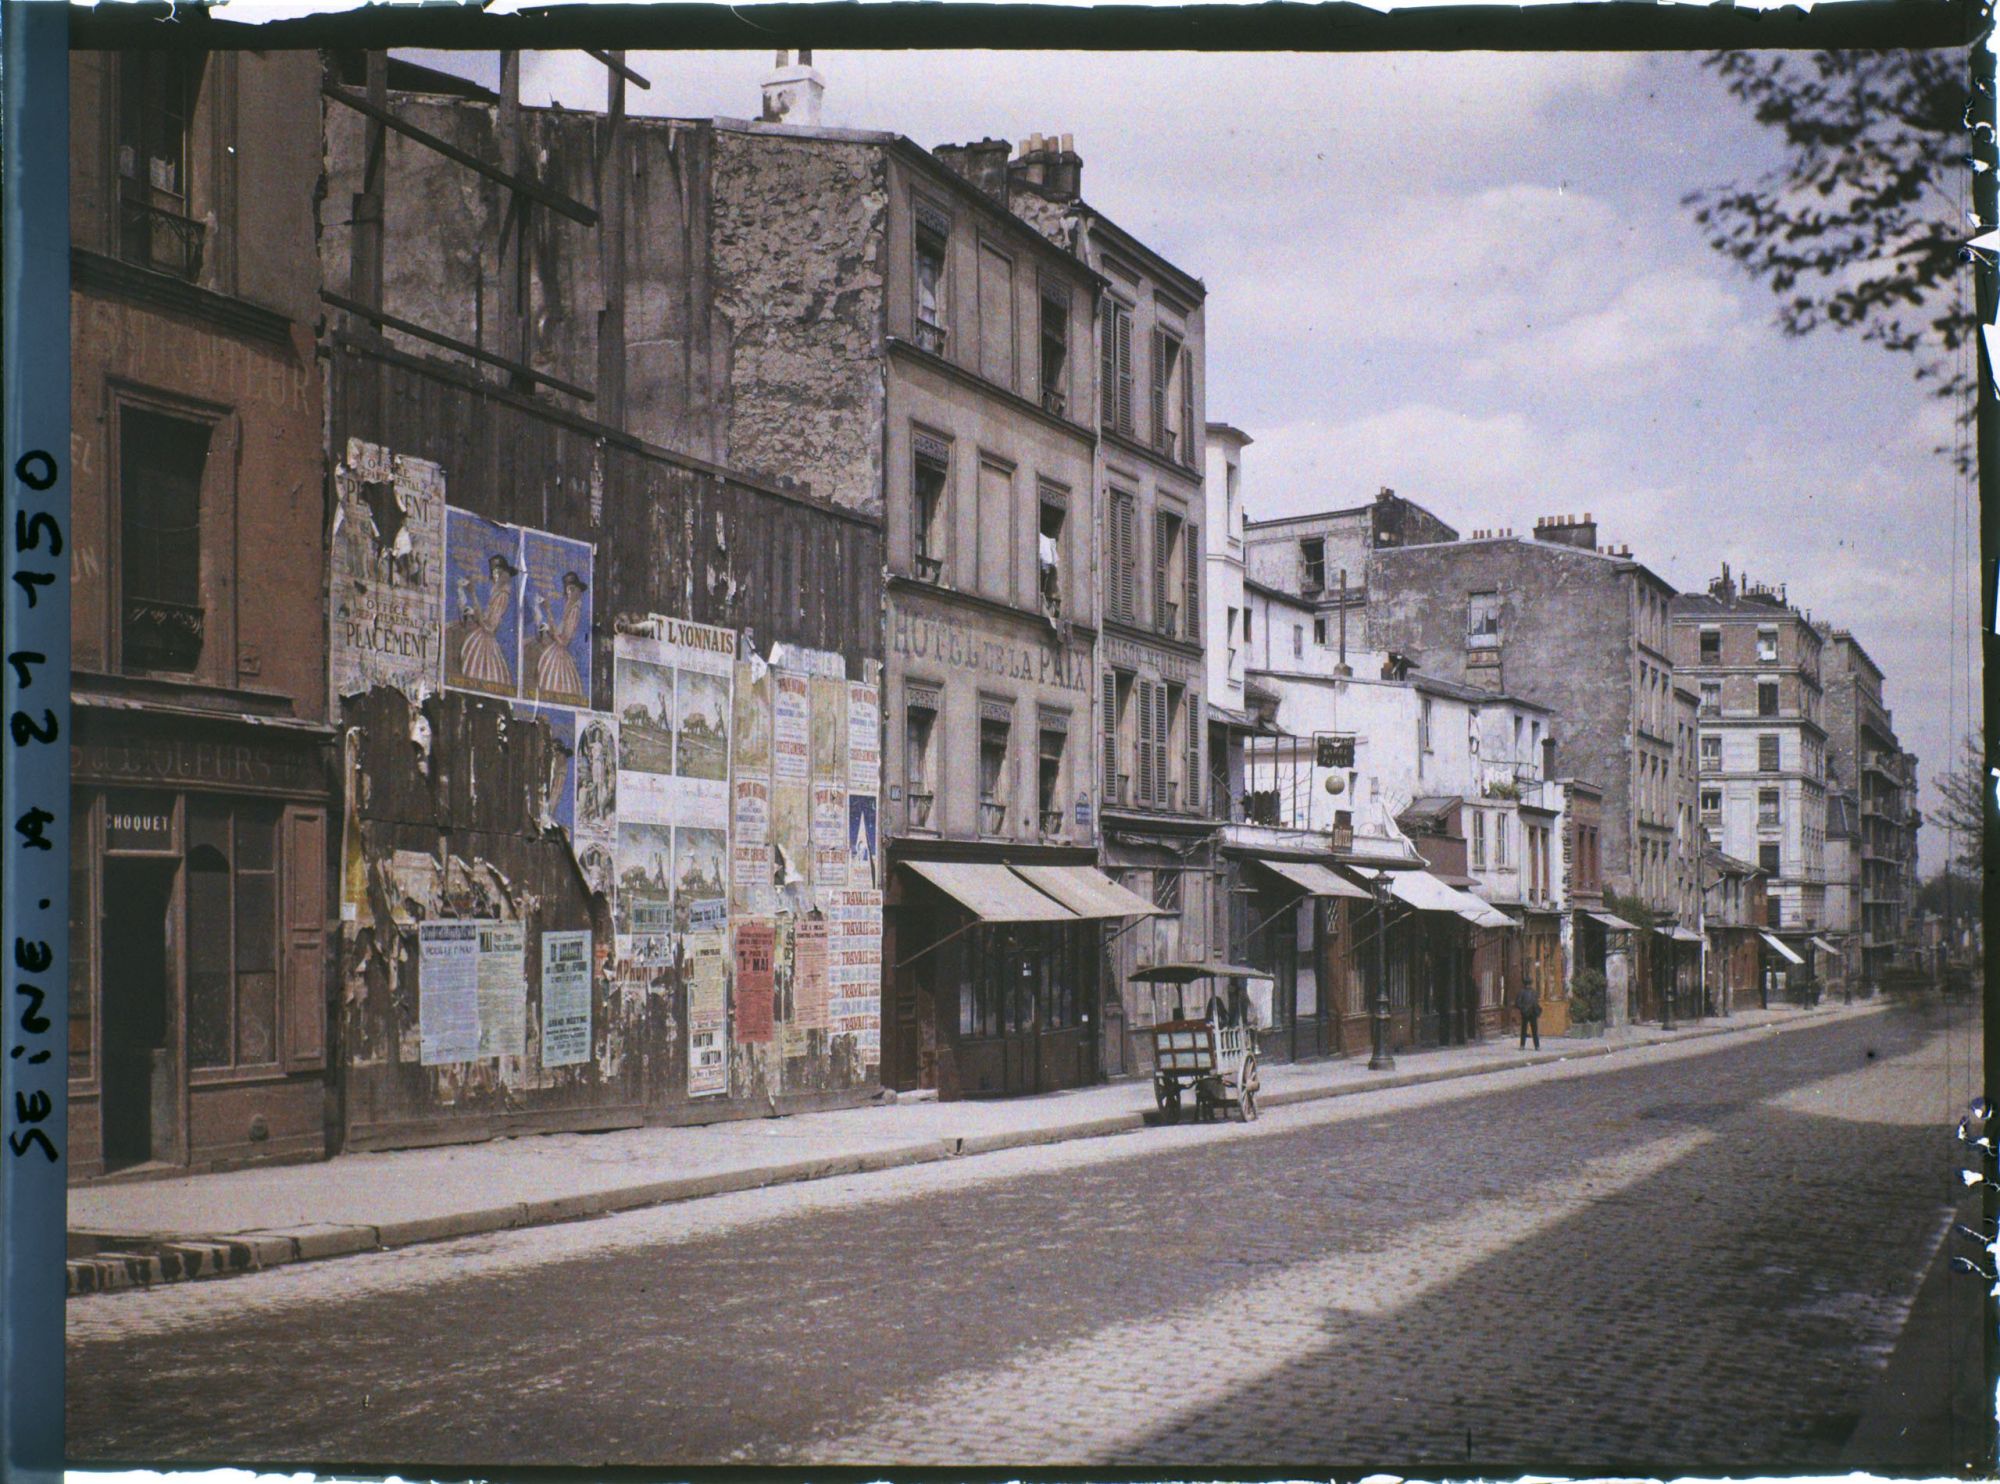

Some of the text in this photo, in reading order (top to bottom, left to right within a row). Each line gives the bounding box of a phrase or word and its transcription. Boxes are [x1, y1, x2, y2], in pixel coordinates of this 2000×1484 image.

[346, 621, 429, 659] PLACEMENT
[668, 621, 734, 655] LYONNAIS
[1007, 648, 1034, 682] LA
[1038, 644, 1087, 692] PAIX
[752, 958, 769, 971] MAI
